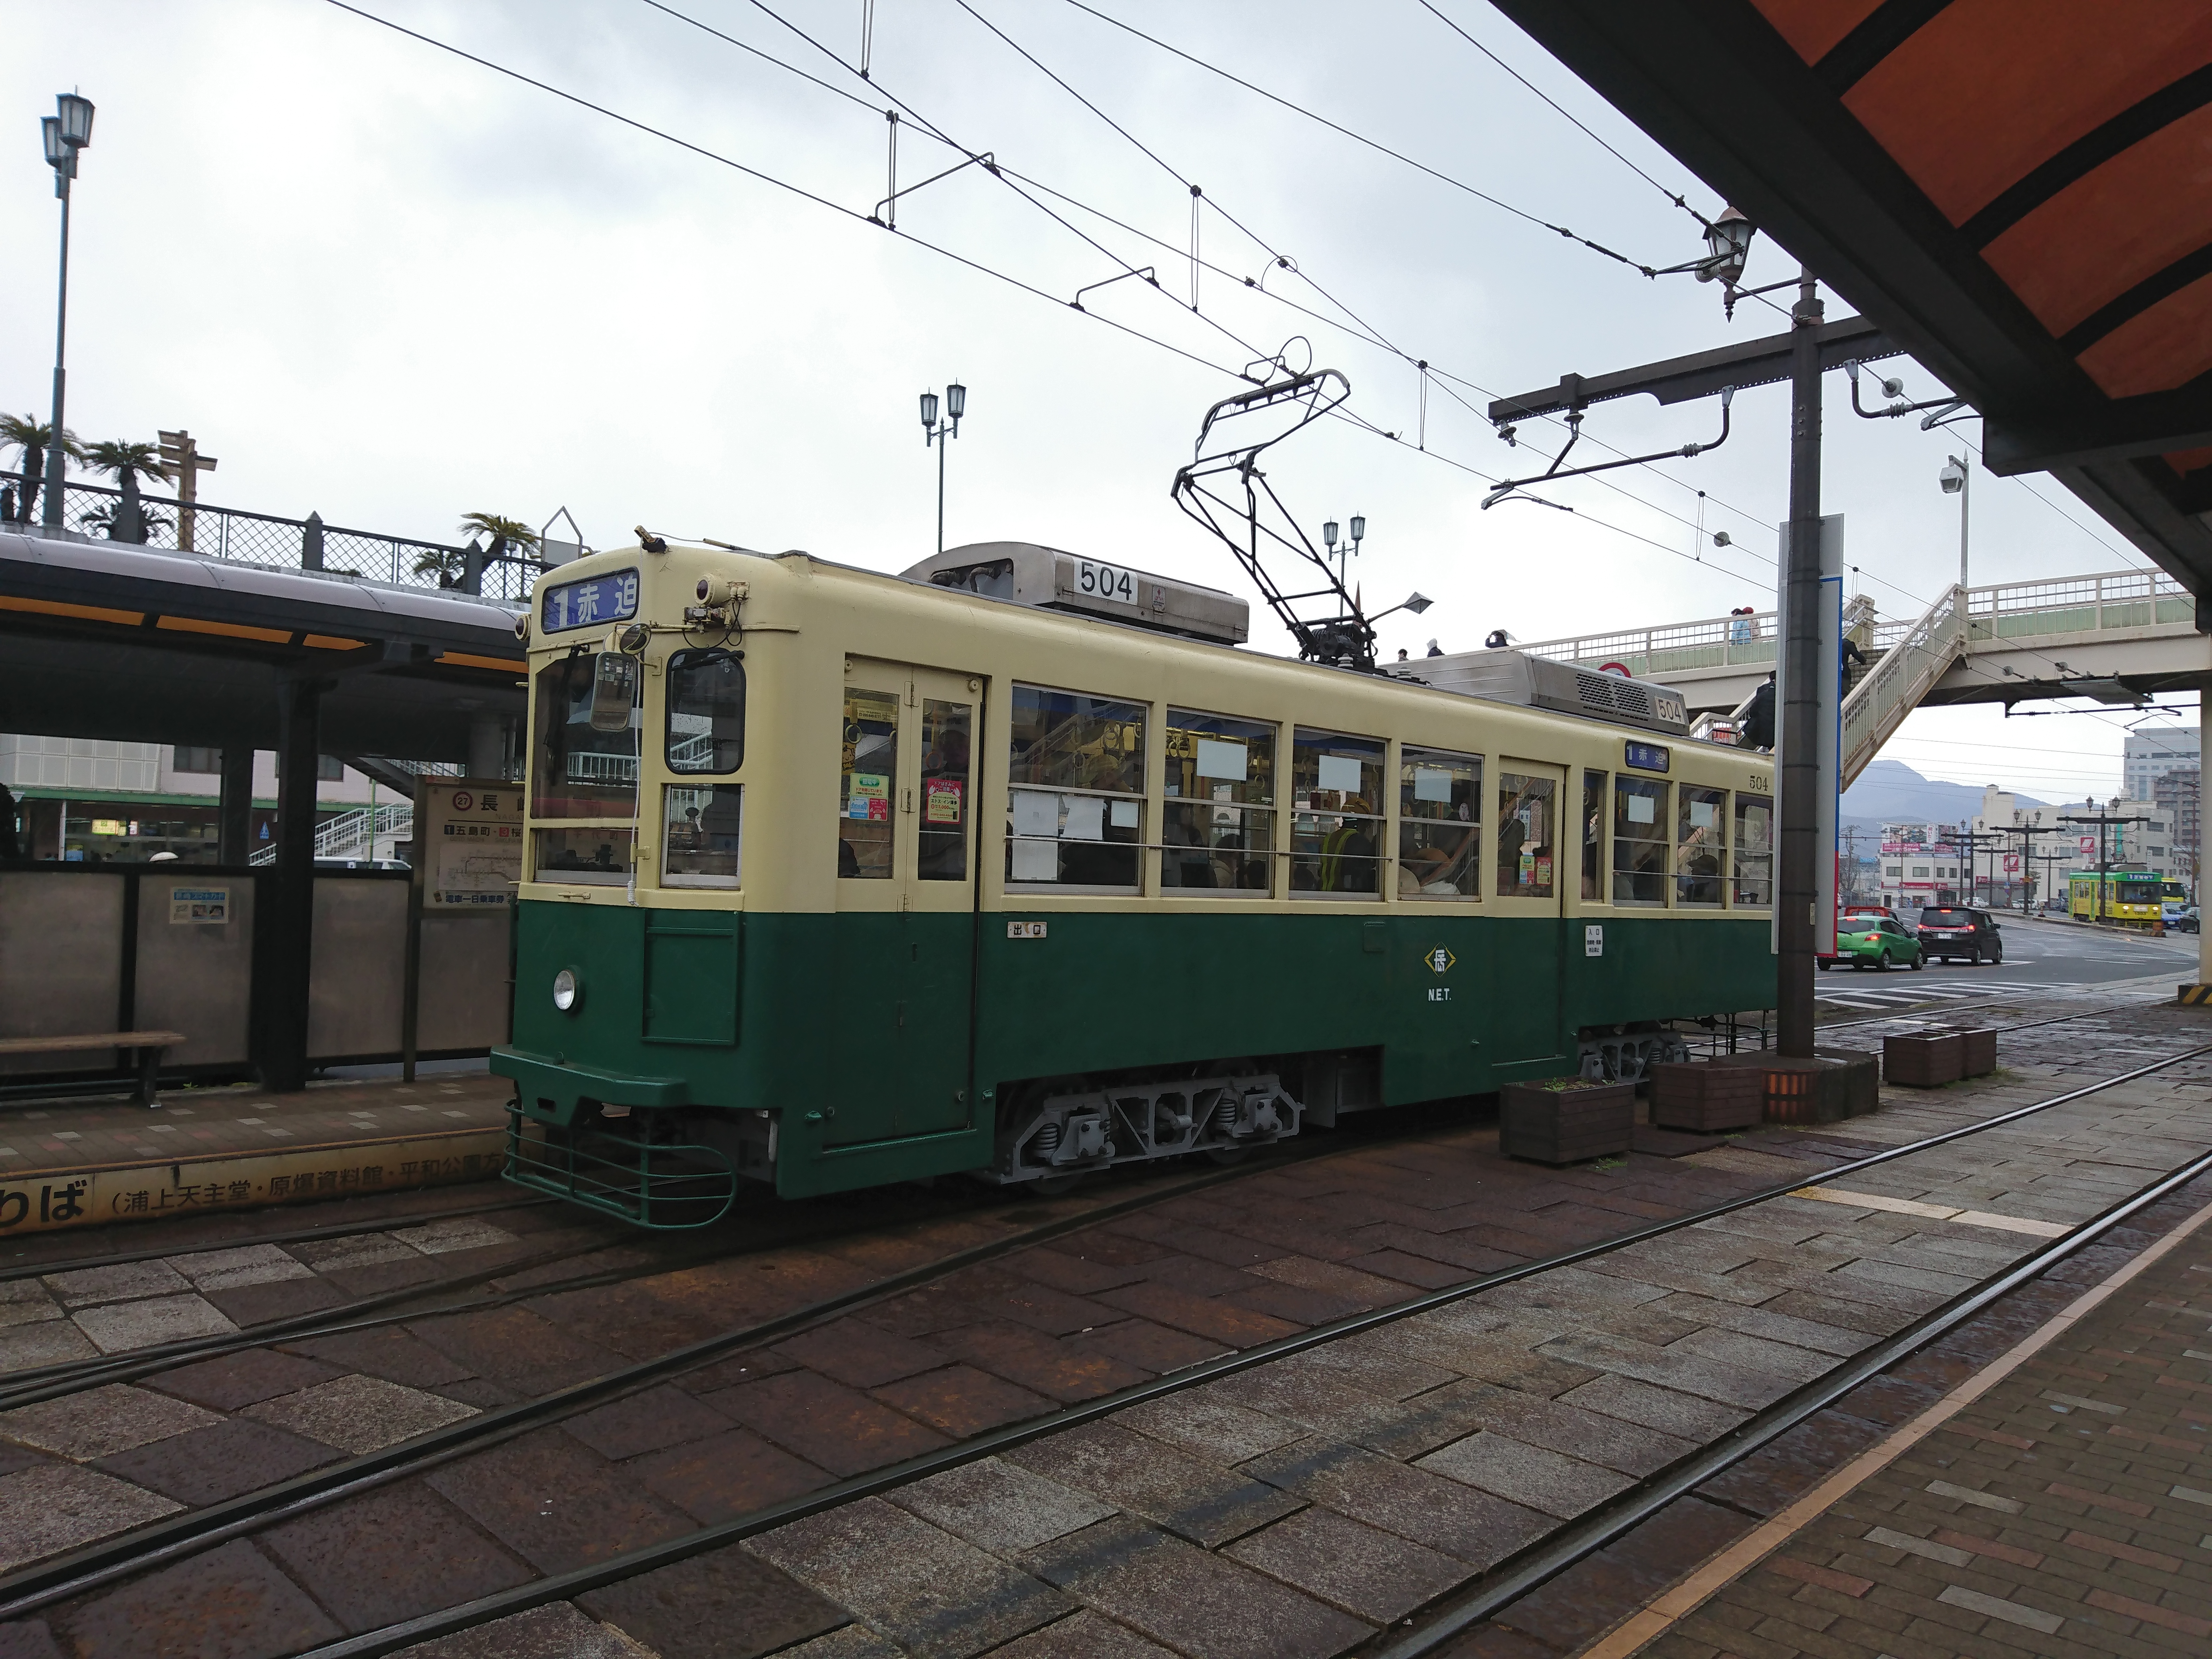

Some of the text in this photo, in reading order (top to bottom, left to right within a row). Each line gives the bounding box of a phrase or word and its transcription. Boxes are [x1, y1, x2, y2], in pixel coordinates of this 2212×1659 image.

[1081, 562, 1132, 601] 504
[554, 573, 637, 627] 1 赤迫
[1658, 700, 1681, 722] 504
[1627, 745, 1666, 765] 1 赤迫
[1750, 775, 1768, 792] 504
[1014, 924, 1041, 935] 出口
[1428, 987, 1452, 1001] N.E.T.
